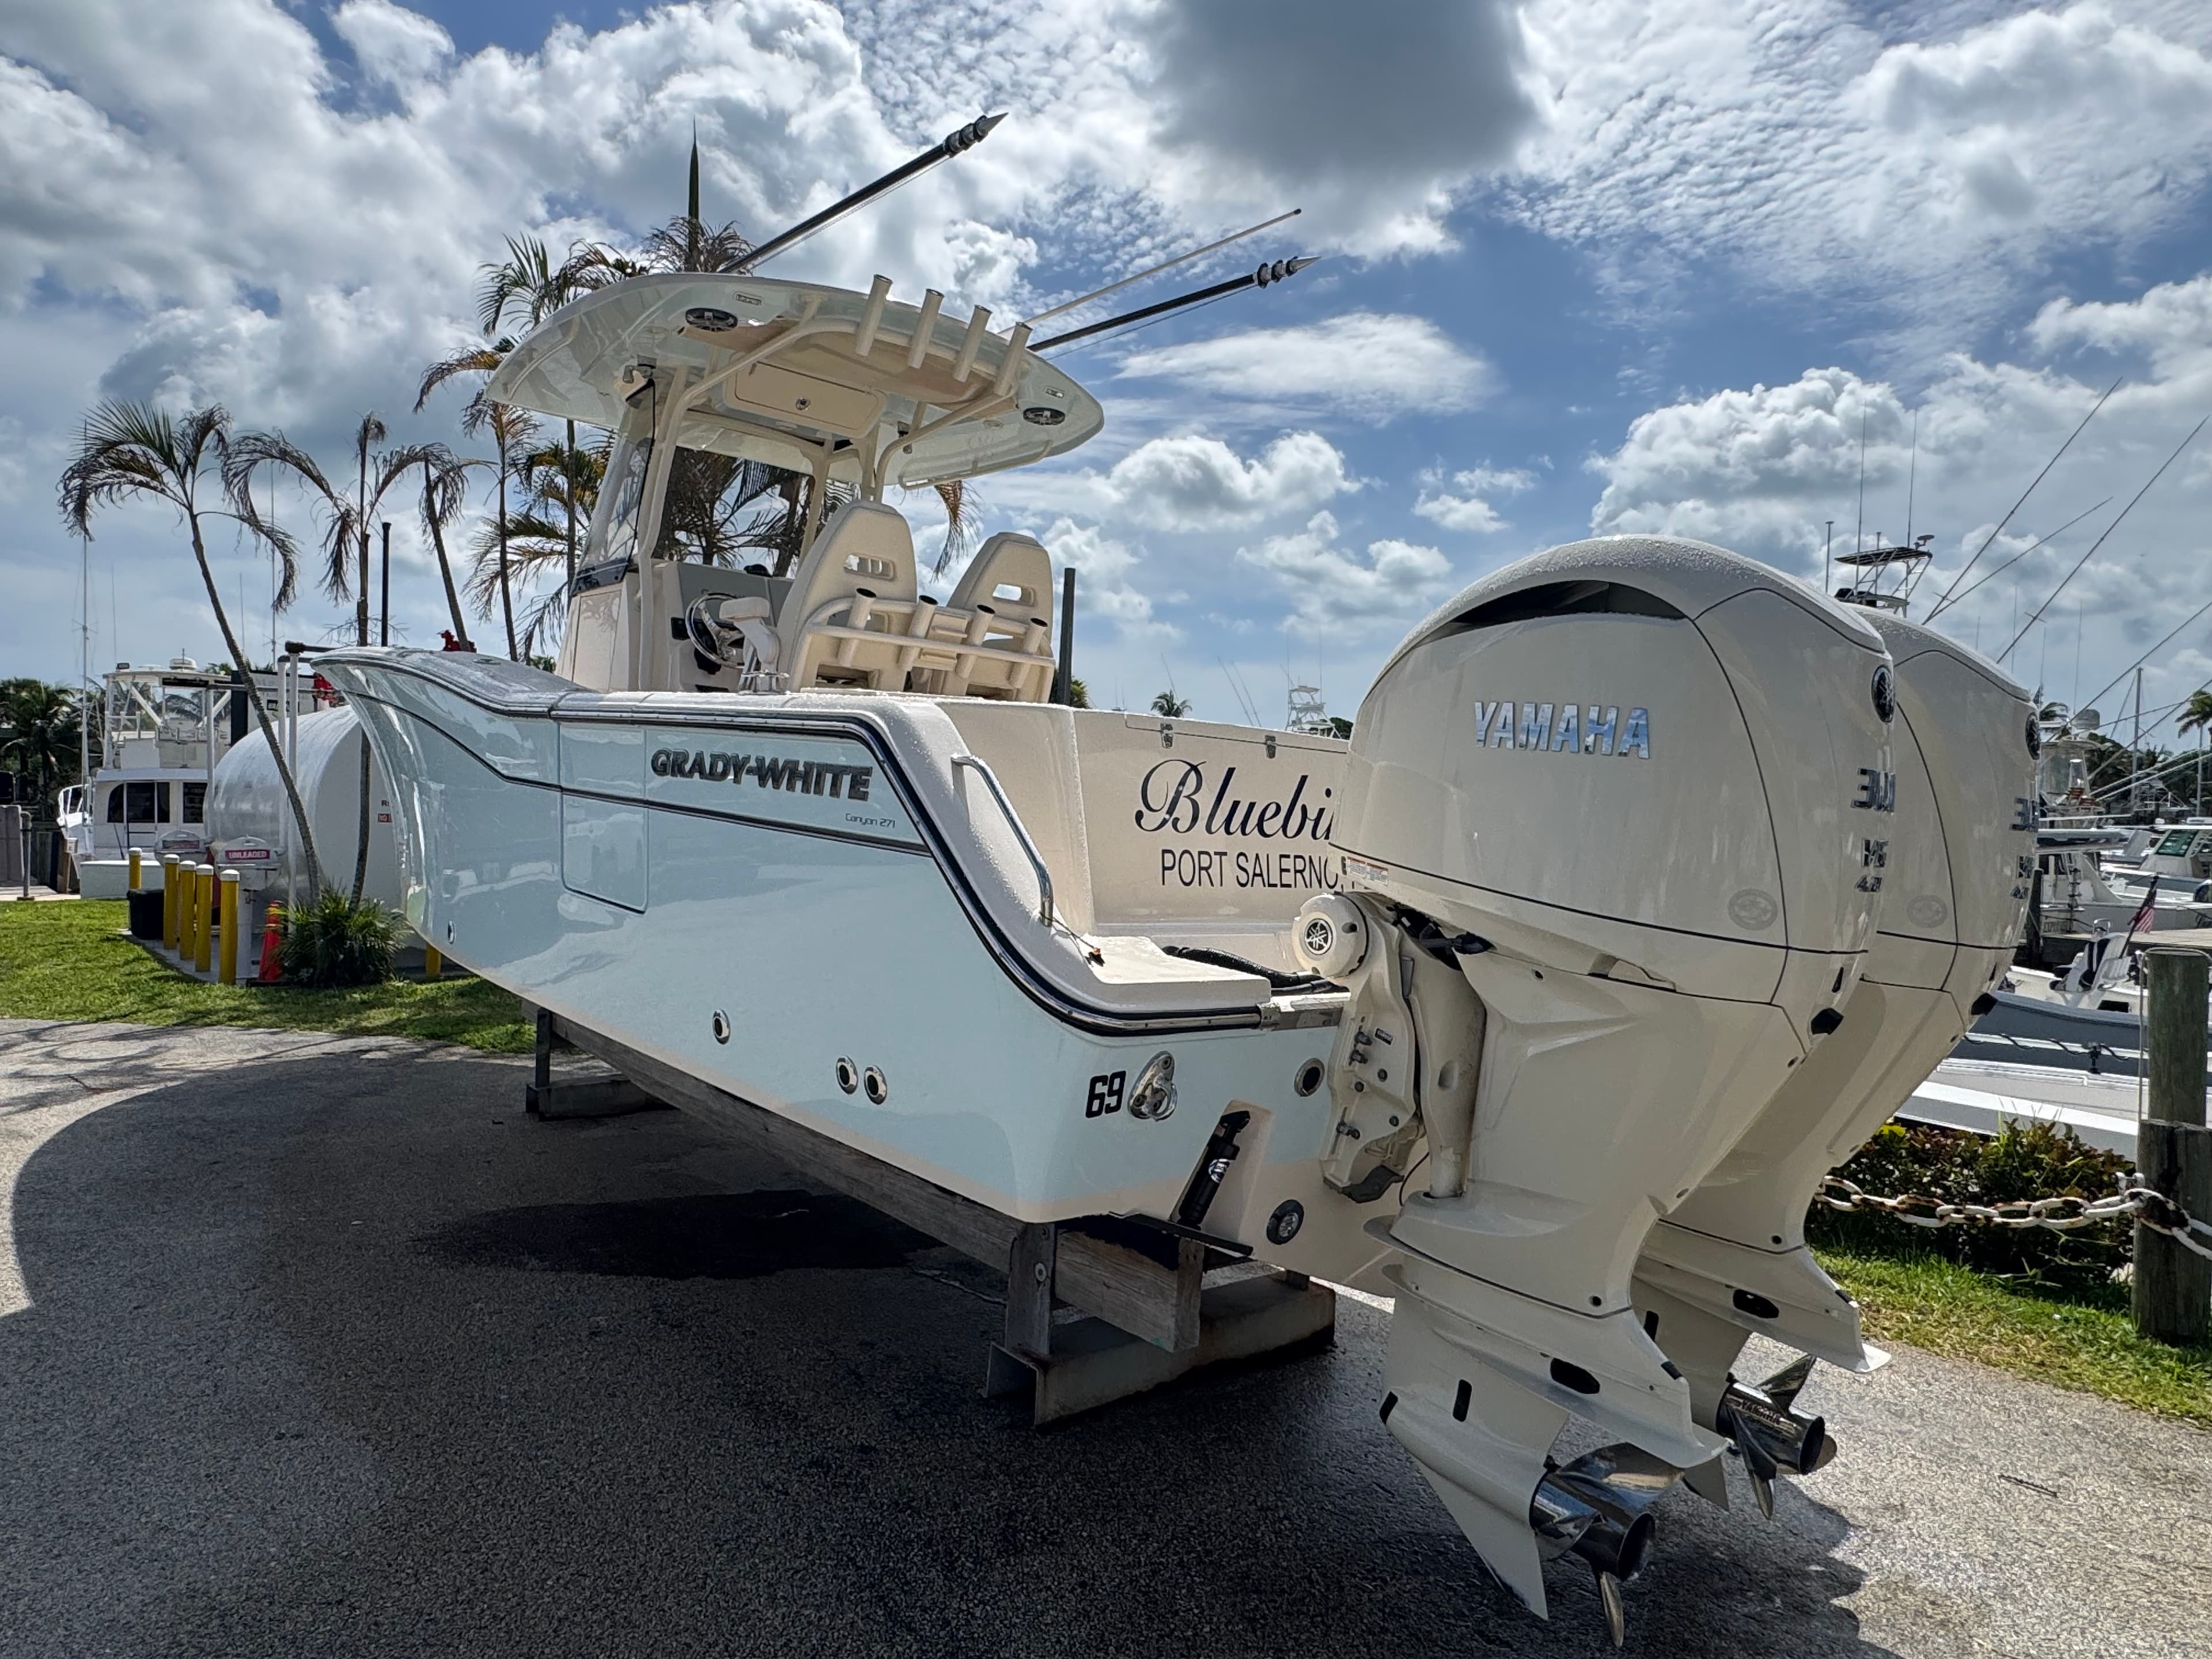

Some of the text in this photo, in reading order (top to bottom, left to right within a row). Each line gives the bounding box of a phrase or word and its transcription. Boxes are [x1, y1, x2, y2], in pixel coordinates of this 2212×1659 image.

[1475, 701, 1650, 759] YAMAHA
[652, 748, 873, 802] GRADY-WHITE
[845, 813, 895, 828] Canyon 271
[228, 851, 267, 859] UNLEADED
[1161, 849, 1228, 888] PORT
[1085, 1070, 1127, 1119] 69
